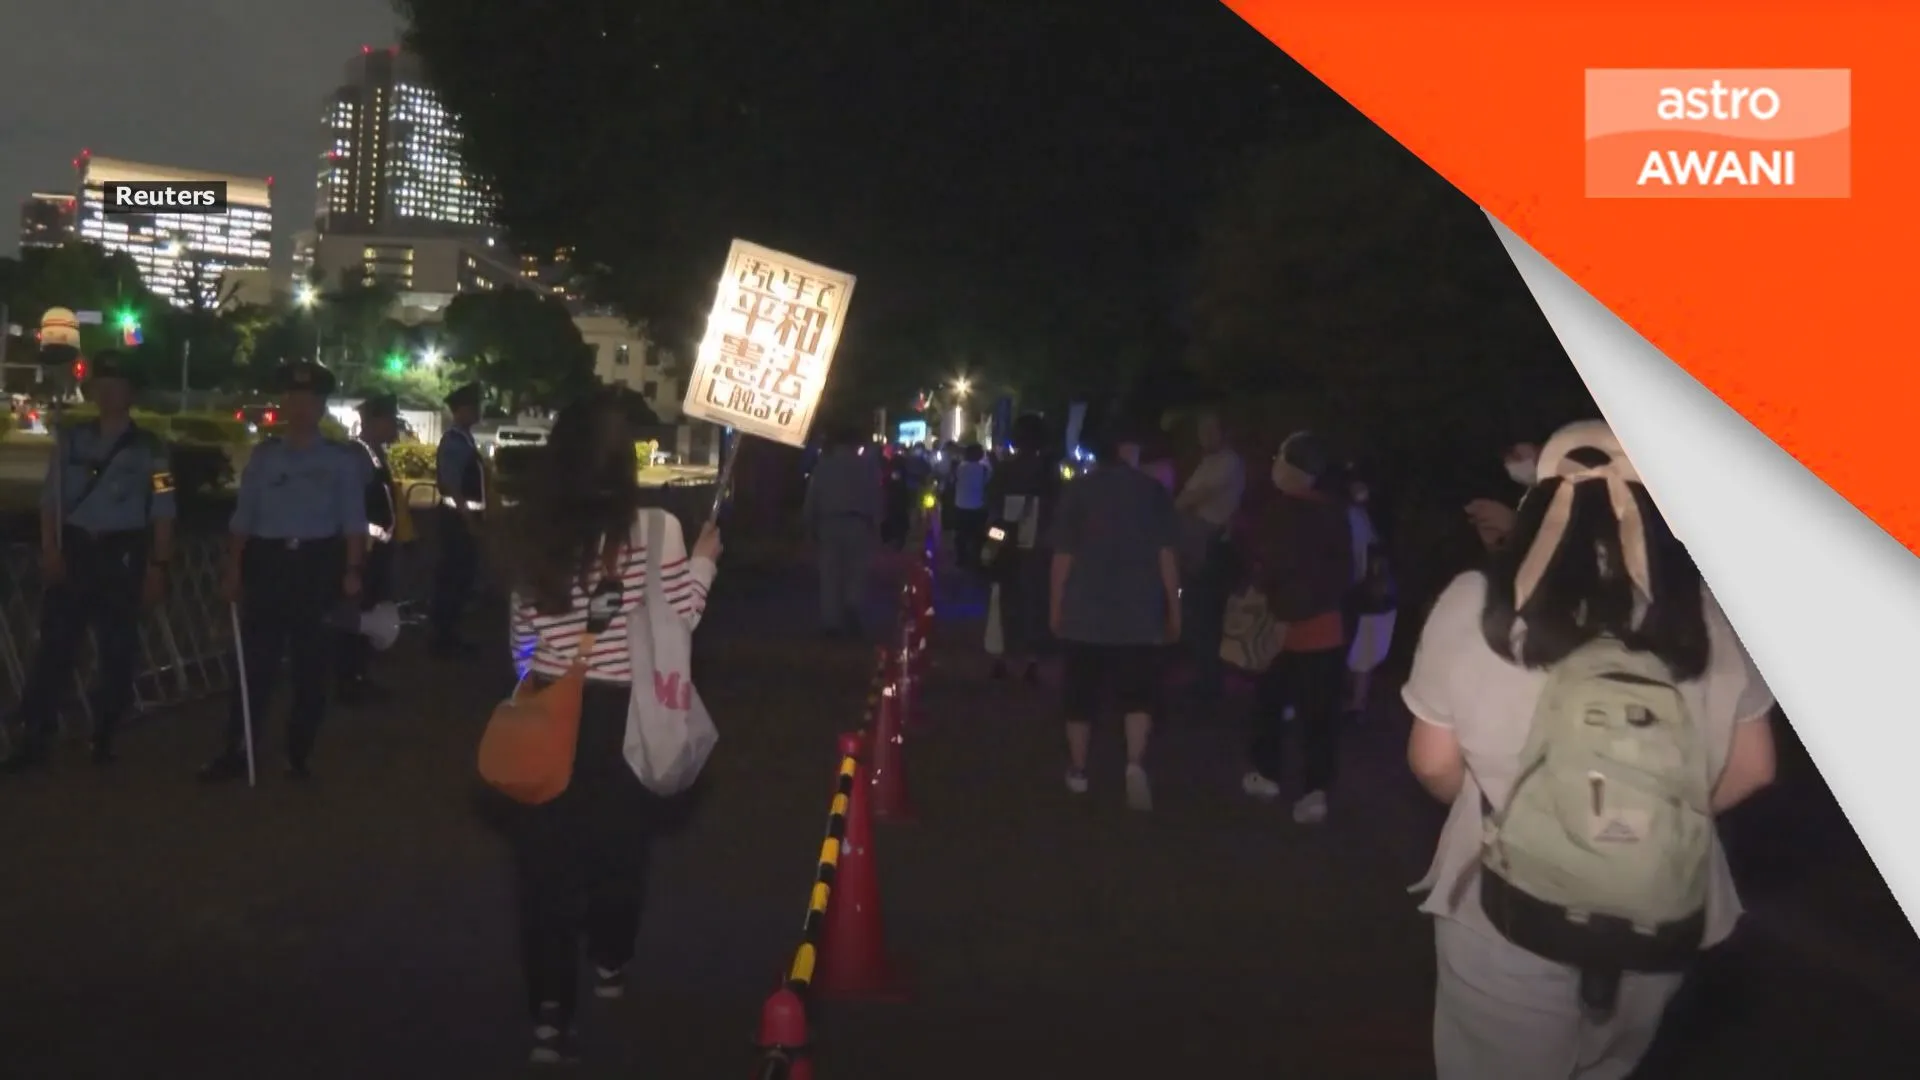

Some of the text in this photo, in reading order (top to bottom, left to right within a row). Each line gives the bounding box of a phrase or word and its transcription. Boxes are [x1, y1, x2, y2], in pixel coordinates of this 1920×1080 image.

[740, 258, 837, 307] 汚い手で
[732, 287, 828, 355] 平和
[713, 334, 808, 400] 憲法
[706, 377, 798, 426] に触るな
